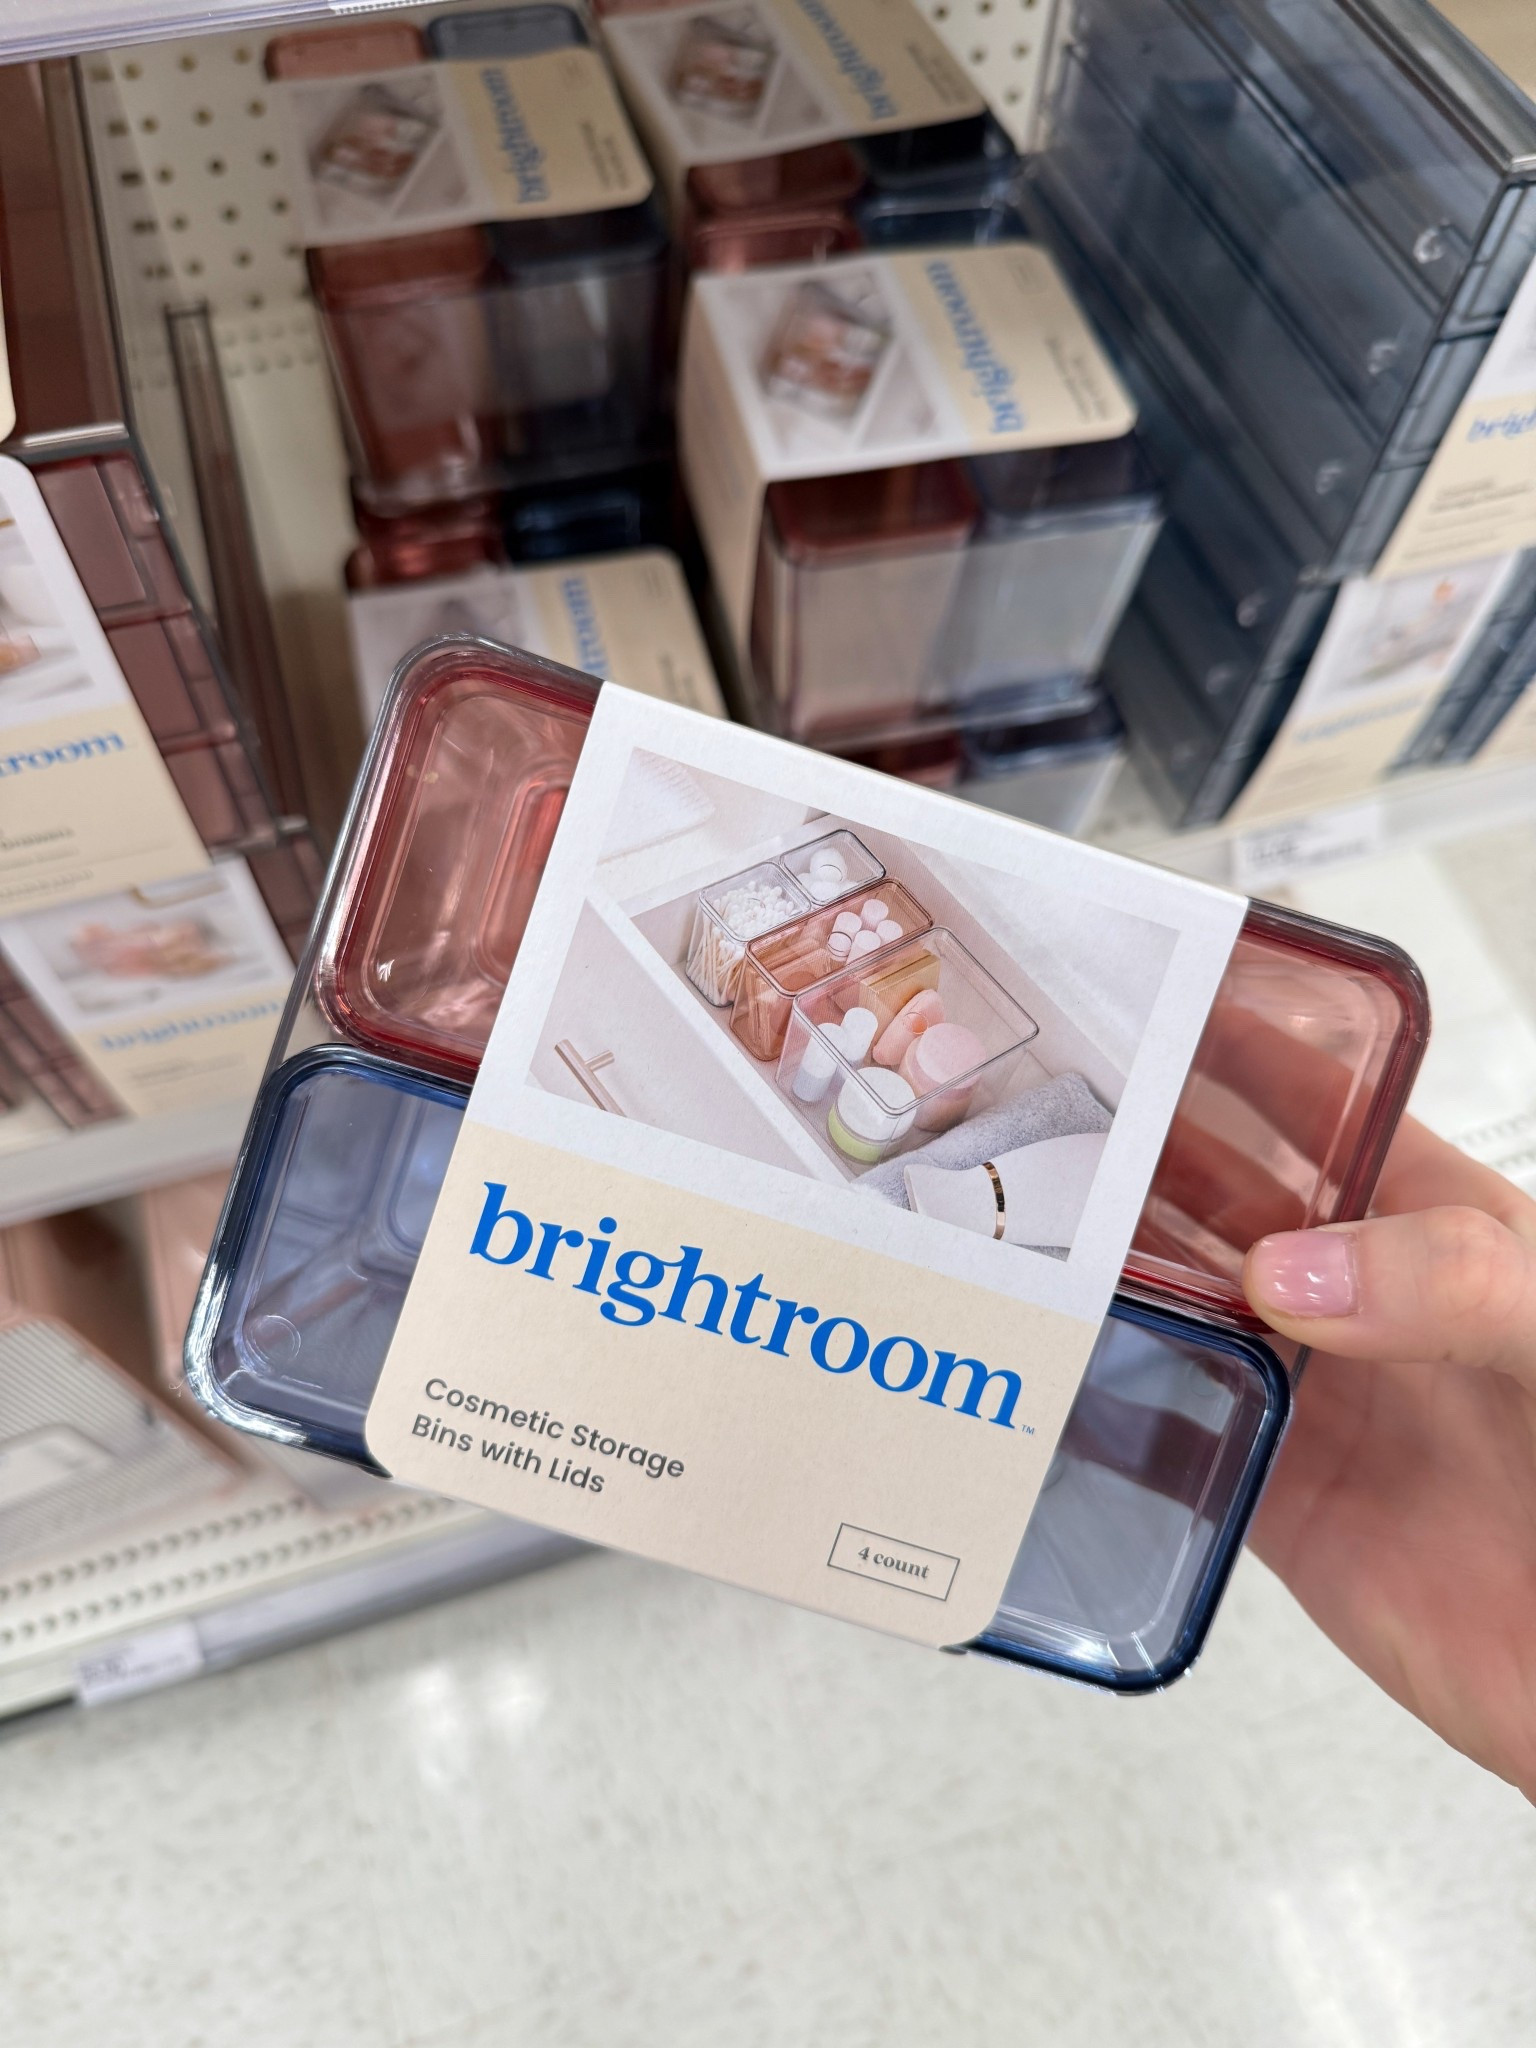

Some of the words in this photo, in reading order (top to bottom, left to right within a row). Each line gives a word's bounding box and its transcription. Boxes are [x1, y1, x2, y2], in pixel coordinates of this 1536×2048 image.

[468, 1181, 1023, 1430] brightroom
[411, 1414, 473, 1452] Bins
[481, 1439, 542, 1474] with
[548, 1457, 605, 1493] Lids
[425, 1378, 564, 1439] Cosmetic
[571, 1424, 685, 1479] Storage
[858, 1546, 870, 1561] 4
[873, 1553, 930, 1579] count
